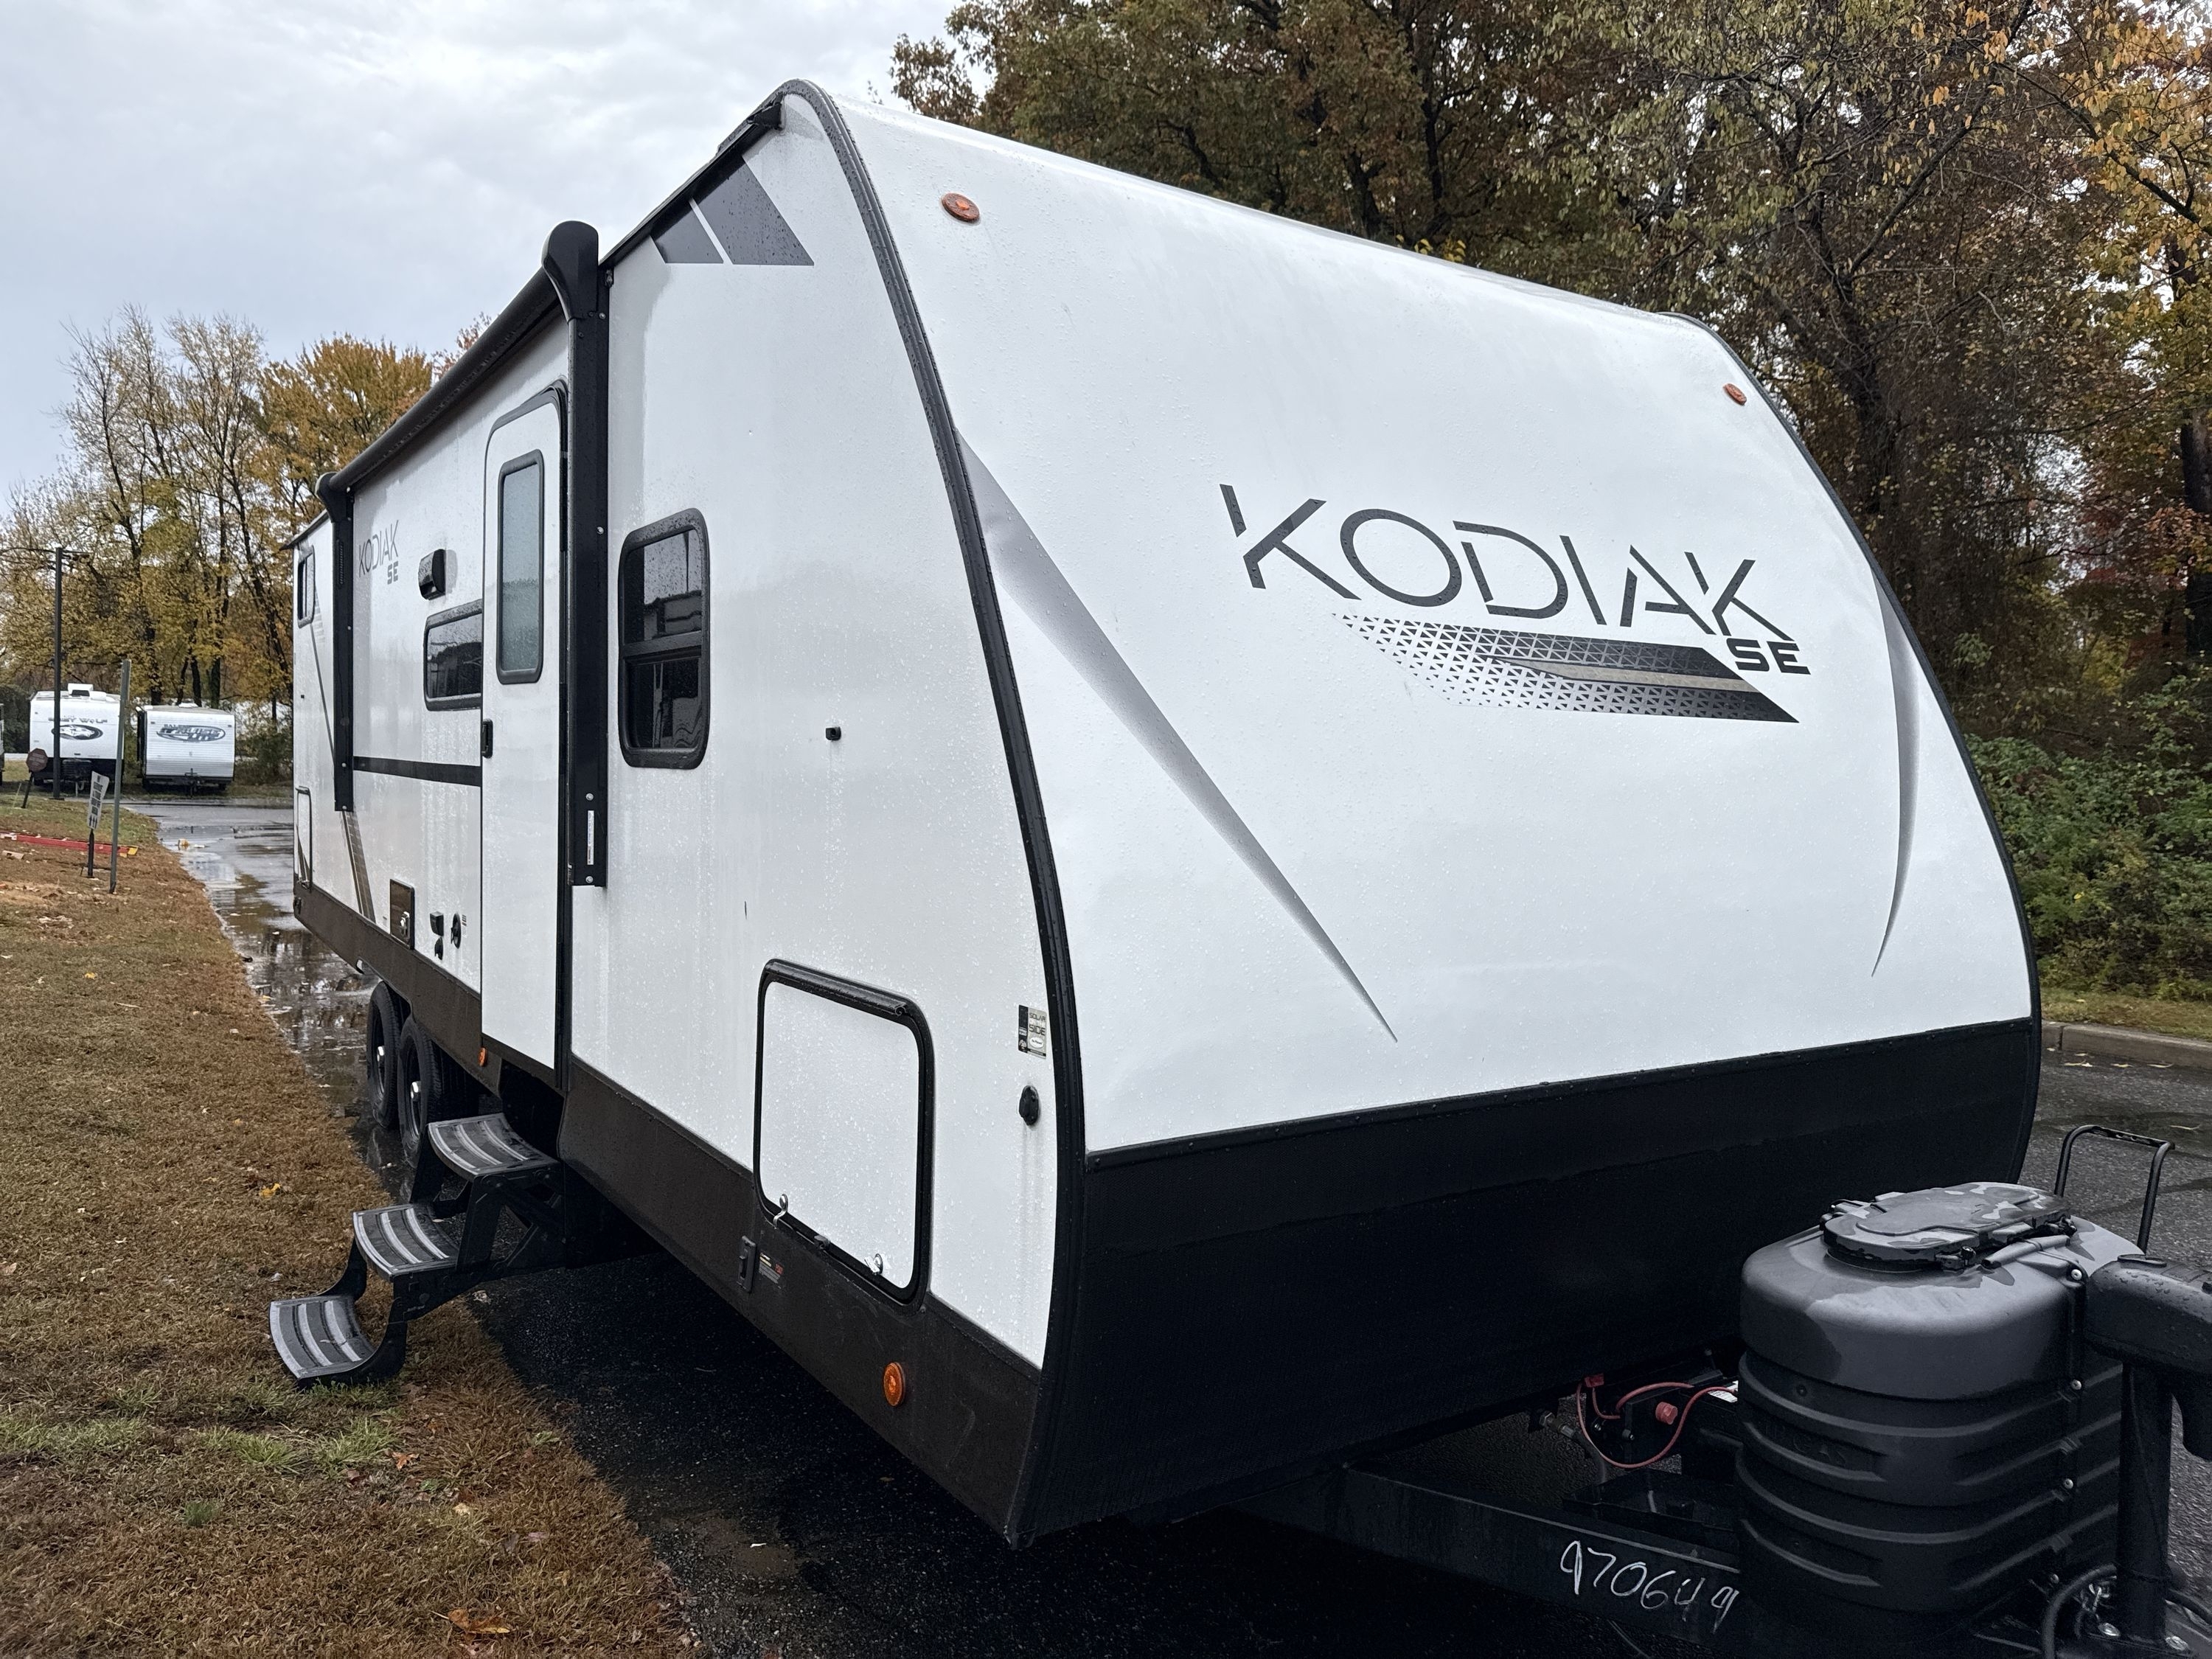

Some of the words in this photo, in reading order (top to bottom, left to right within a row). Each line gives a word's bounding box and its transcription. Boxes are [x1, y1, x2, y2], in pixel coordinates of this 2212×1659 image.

[358, 519, 399, 578] KODIAK
[1219, 483, 1795, 641] KODIAK
[387, 560, 398, 585] SE
[1726, 637, 1812, 675] SE
[1029, 1012, 1046, 1022] SOLAR
[1029, 1023, 1046, 1037] SIDE
[1559, 1540, 1740, 1635] 970649
